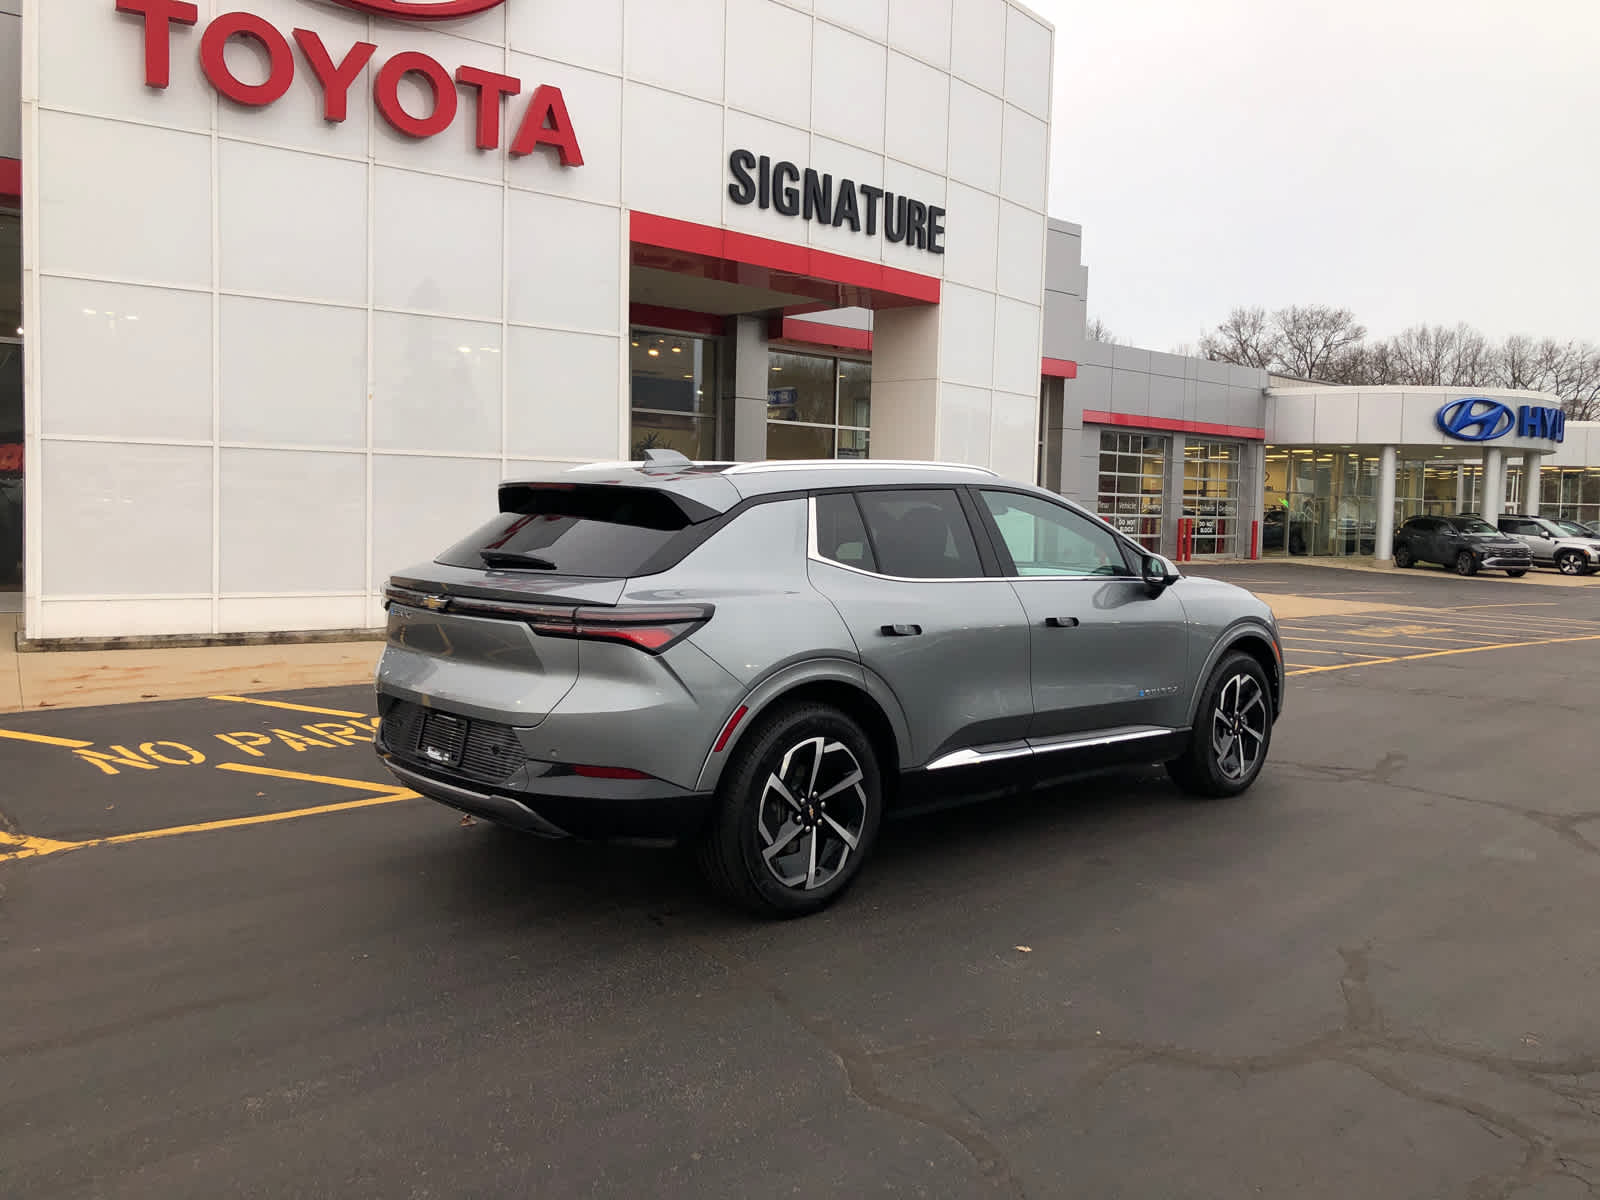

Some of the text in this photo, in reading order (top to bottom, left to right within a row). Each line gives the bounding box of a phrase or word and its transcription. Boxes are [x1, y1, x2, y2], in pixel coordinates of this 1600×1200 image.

[115, 0, 584, 168] TOYOTA
[728, 149, 946, 254] SIGNATURE
[72, 741, 206, 775] NO
